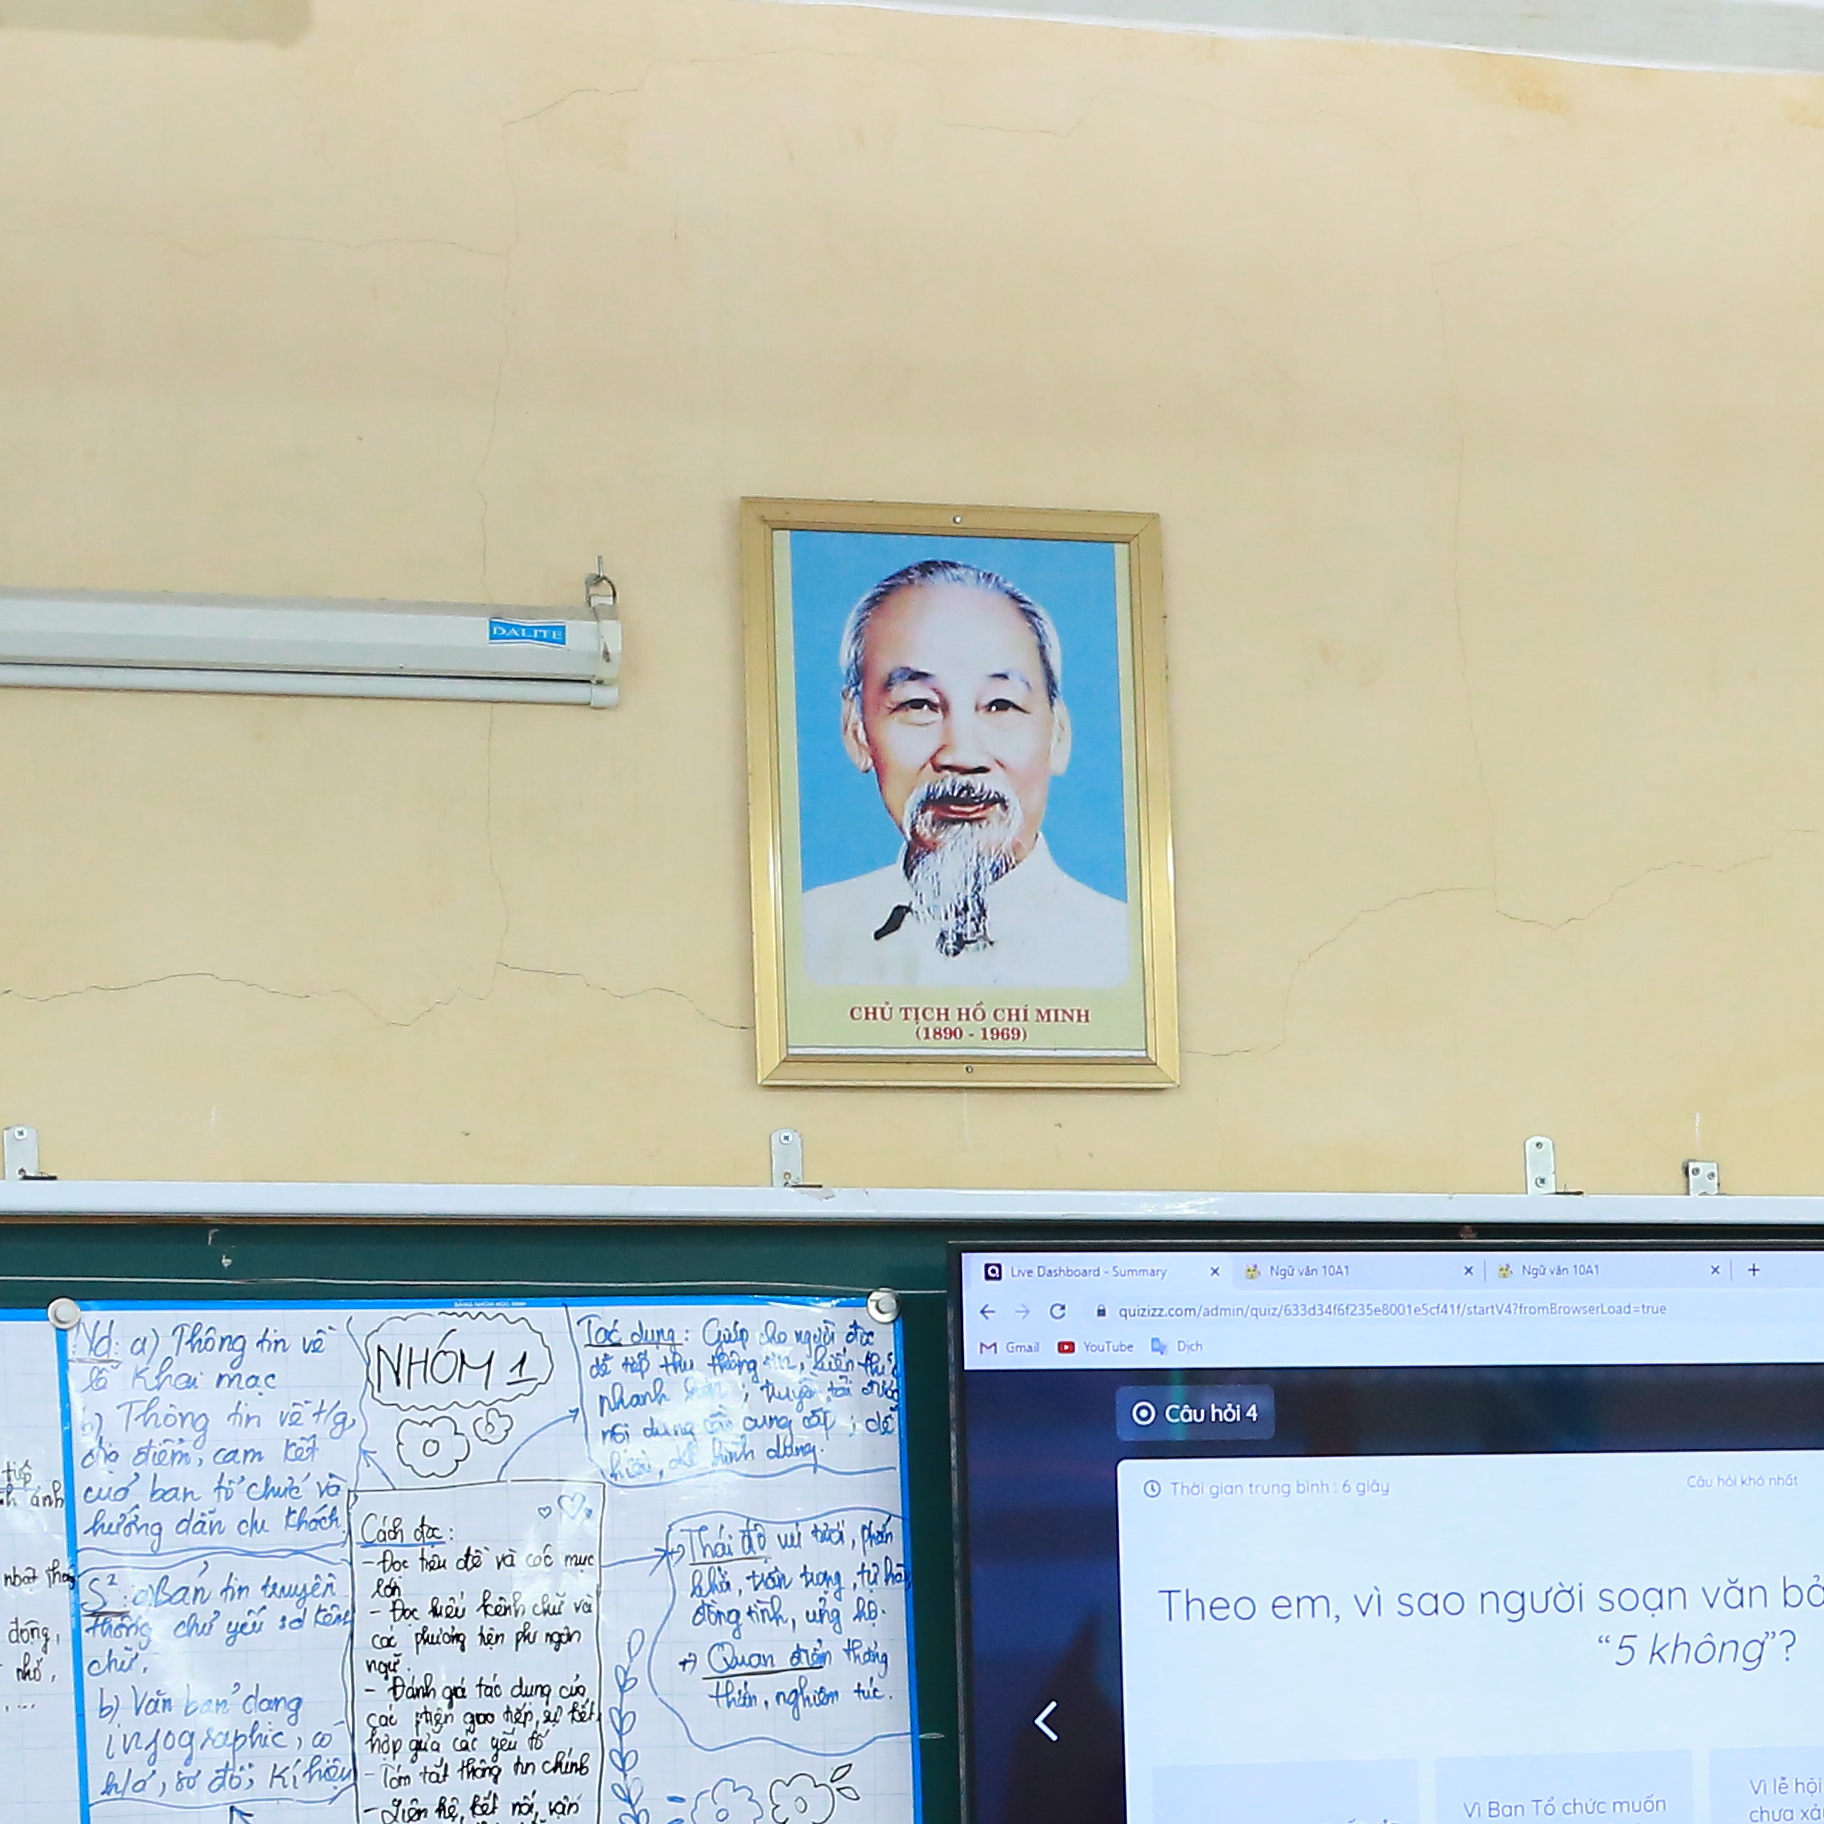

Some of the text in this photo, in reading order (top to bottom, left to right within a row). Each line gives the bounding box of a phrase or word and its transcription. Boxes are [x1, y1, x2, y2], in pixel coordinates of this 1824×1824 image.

[493, 626, 563, 640] DALITE
[850, 1001, 1091, 1025] CHỦ TỊCH HỒ CHÍ MINH
[916, 1026, 1028, 1041] (1890 1969)
[1011, 1265, 1167, 1280] Live Dashboard Summary
[1270, 1264, 1294, 1280] Ngữ
[1321, 1264, 1350, 1278] 10A1
[172, 1322, 246, 1370] Thông
[256, 1327, 290, 1353] tin
[1006, 1342, 1040, 1354] Gmail
[1084, 1341, 1134, 1353] YouTube
[1178, 1340, 1203, 1353] Dịch
[377, 1328, 538, 1393] NHÓM 1
[216, 1375, 277, 1397] mạc
[1165, 1403, 1258, 1423] Câu hỏi 4
[1171, 1481, 1204, 1496] Thời
[1209, 1482, 1244, 1498] gian
[1249, 1483, 1290, 1497] trung
[1342, 1480, 1350, 1493] 6
[1356, 1480, 1390, 1496] giây
[1158, 1589, 1256, 1621] Theo
[1271, 1594, 1341, 1623] em,
[1354, 1586, 1381, 1618] vì
[1397, 1594, 1465, 1618] sao
[1479, 1582, 1585, 1623] người
[1598, 1587, 1687, 1618] soạn
[1702, 1579, 1768, 1609] văn
[1598, 1629, 1797, 1672] “5 không”?
[1749, 1779, 1767, 1795] Vì
[1773, 1777, 1789, 1795] lễ
[1795, 1778, 1822, 1796] hội
[1463, 1794, 1666, 1819] Vì Ban Tổ chức muốn
[1749, 1806, 1794, 1823] chưa
